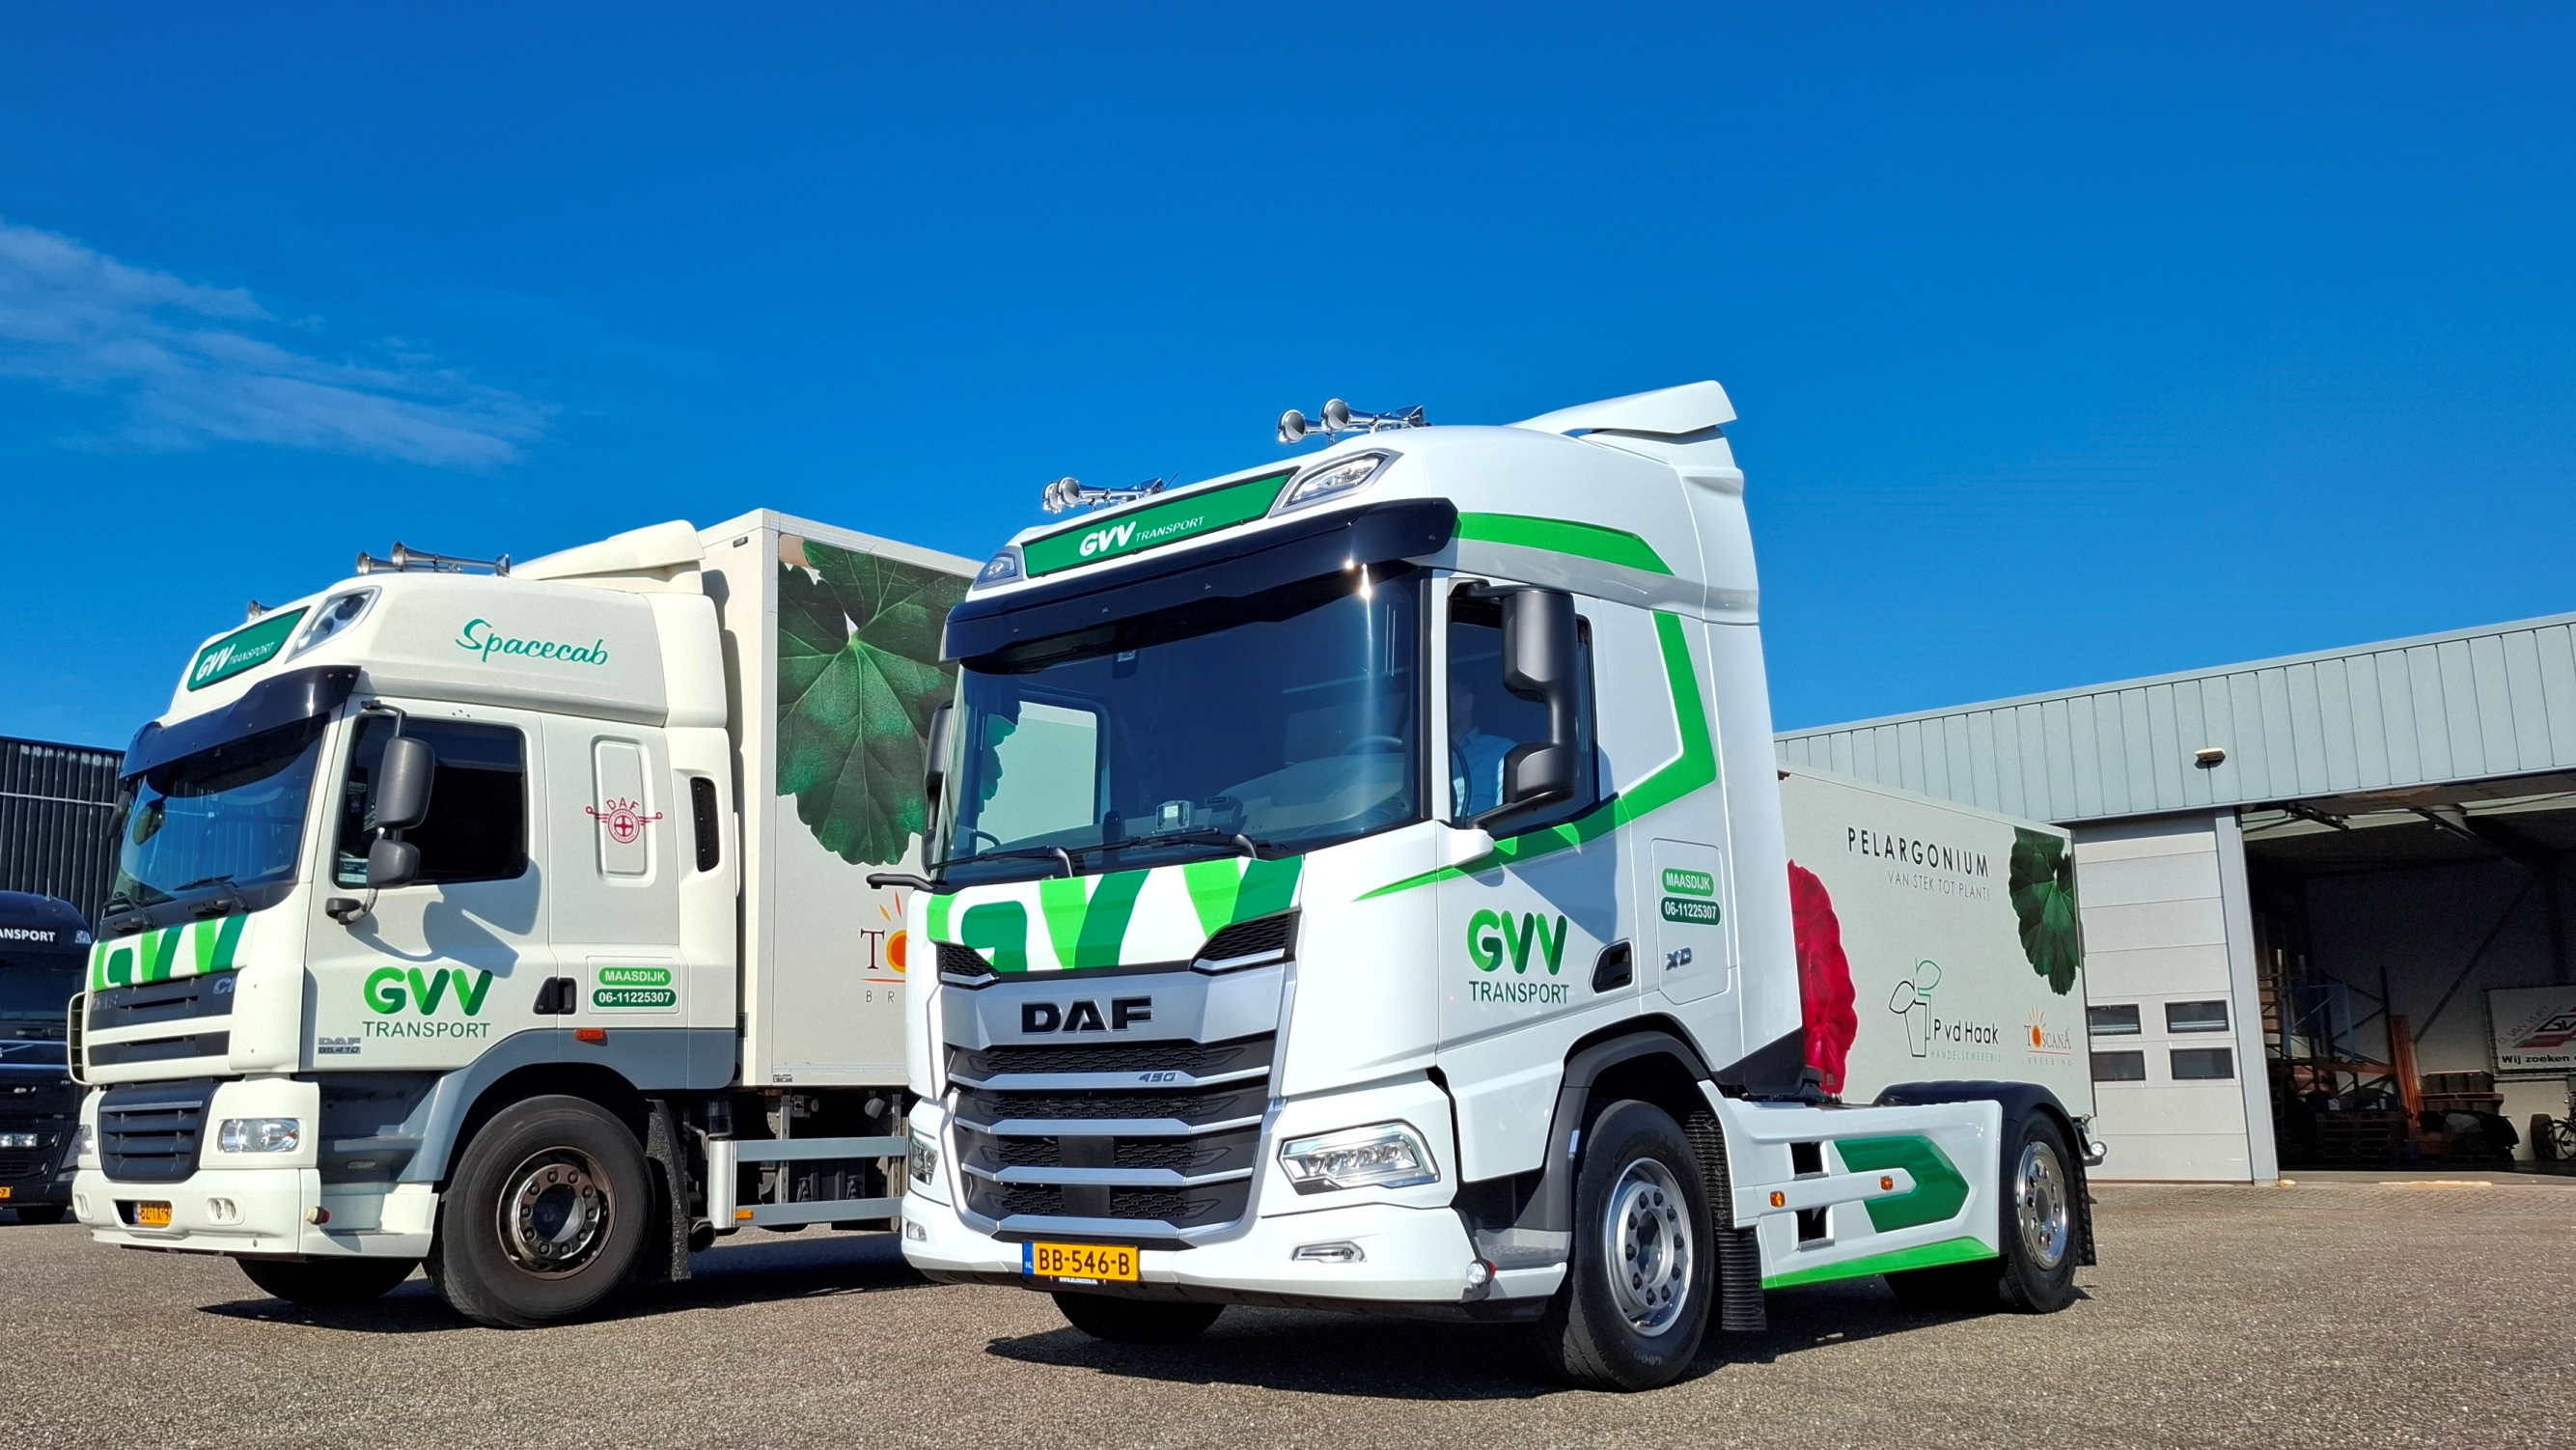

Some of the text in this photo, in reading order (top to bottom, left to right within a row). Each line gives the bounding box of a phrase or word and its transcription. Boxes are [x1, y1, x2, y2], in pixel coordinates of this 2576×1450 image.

[1079, 516, 1205, 557] GVV TRANSPORT
[455, 618, 609, 665] Spacecab
[196, 641, 276, 682] GVV TRANSPORT
[605, 796, 640, 811] DAF
[1847, 826, 1989, 878] PELARGONIUM
[1666, 872, 1711, 891] MAASDIJK
[1887, 870, 1991, 903] VAN STEK TOT PLANT!
[1664, 901, 1717, 920] 06-11225307
[1467, 908, 1568, 976] GVV
[1665, 946, 1693, 971] XD
[605, 970, 665, 982] MAASDIJK
[363, 966, 494, 1017] GVV
[598, 991, 671, 1003] 06-11225307
[1468, 980, 1570, 1004] TRANSPORT
[1020, 994, 1154, 1036] DAF
[319, 1037, 361, 1046] DAF
[362, 1020, 491, 1038] TRANSPORT
[1965, 1021, 2000, 1046] Haak
[2502, 1055, 2522, 1065] Wij
[2525, 1054, 2570, 1063] zoeken
[1039, 1248, 1130, 1276] BB-546-B
